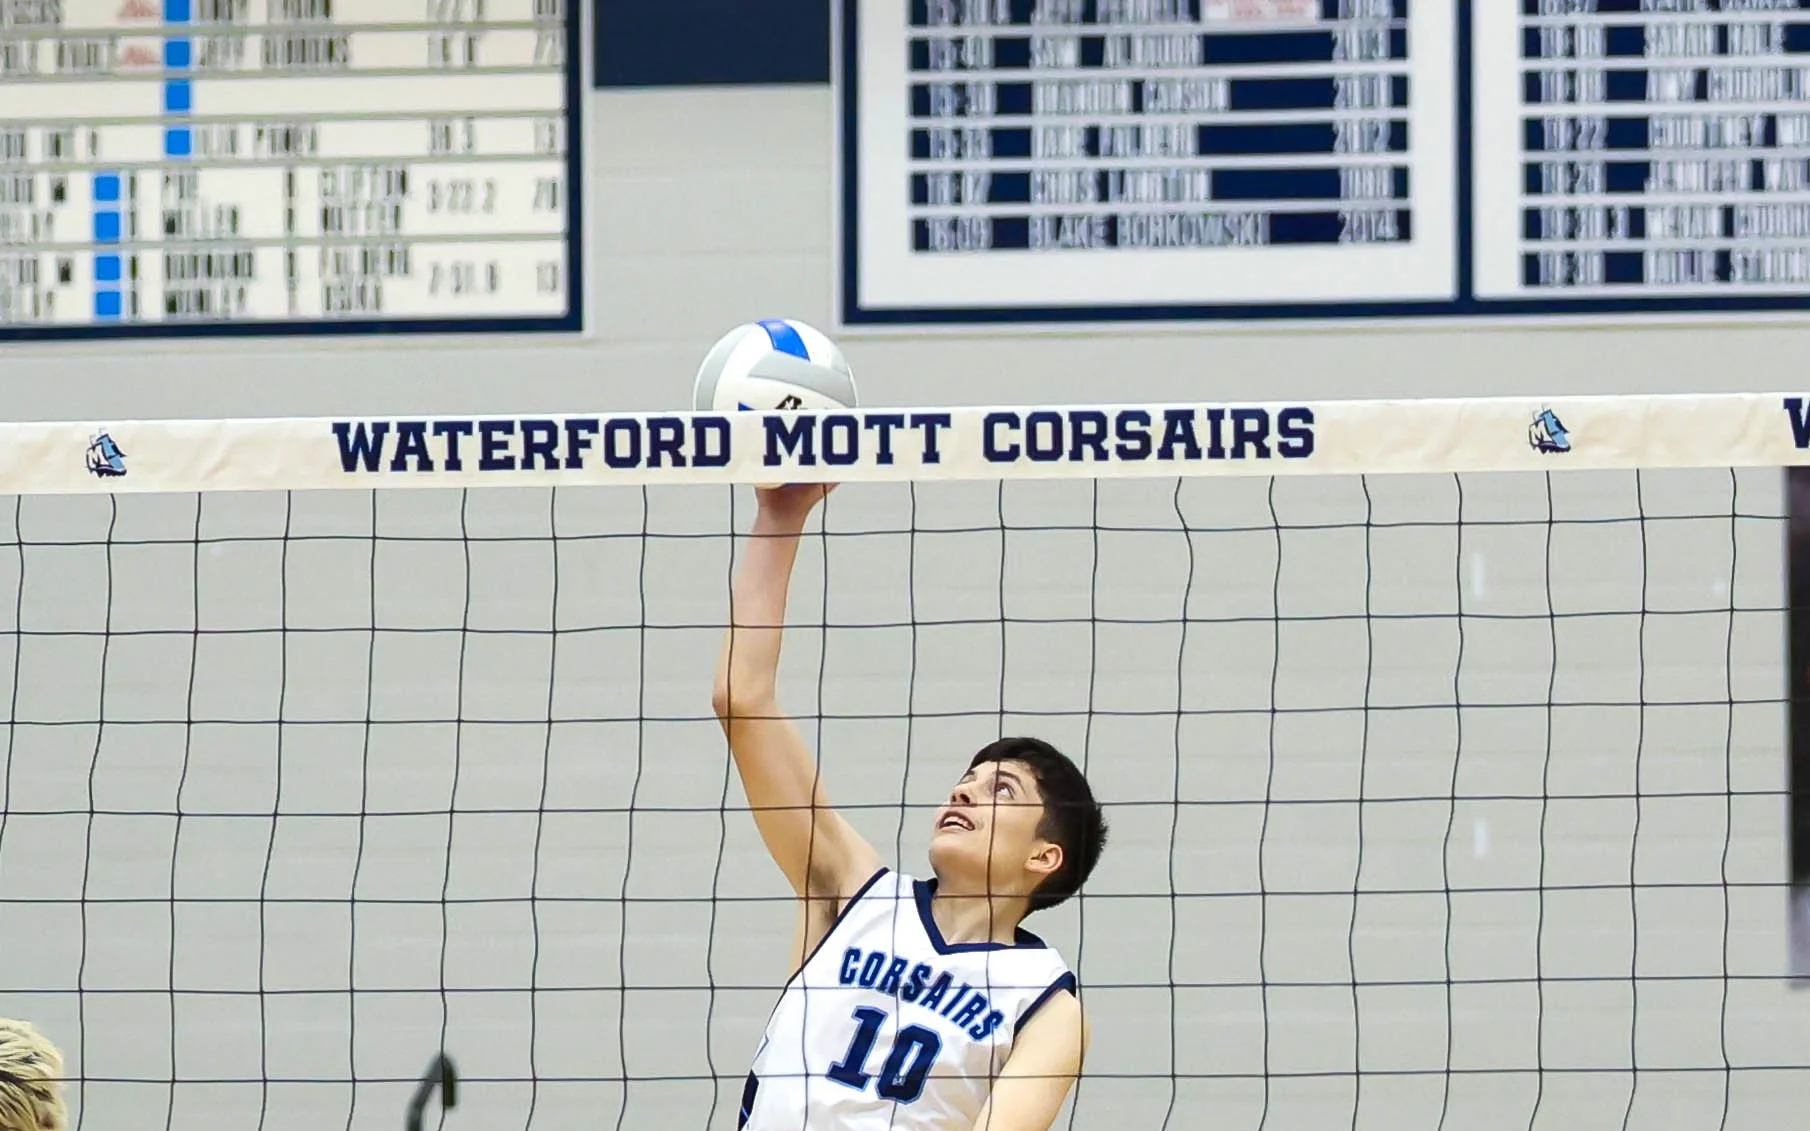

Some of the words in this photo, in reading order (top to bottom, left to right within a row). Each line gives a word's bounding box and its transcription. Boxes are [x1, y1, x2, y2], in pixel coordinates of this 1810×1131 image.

[332, 416, 731, 472] WATERFORD
[762, 412, 951, 467] MOTT
[982, 406, 1315, 463] CORSAIRS
[839, 946, 1004, 1042] CORSAIRS
[826, 1005, 943, 1105] 10
